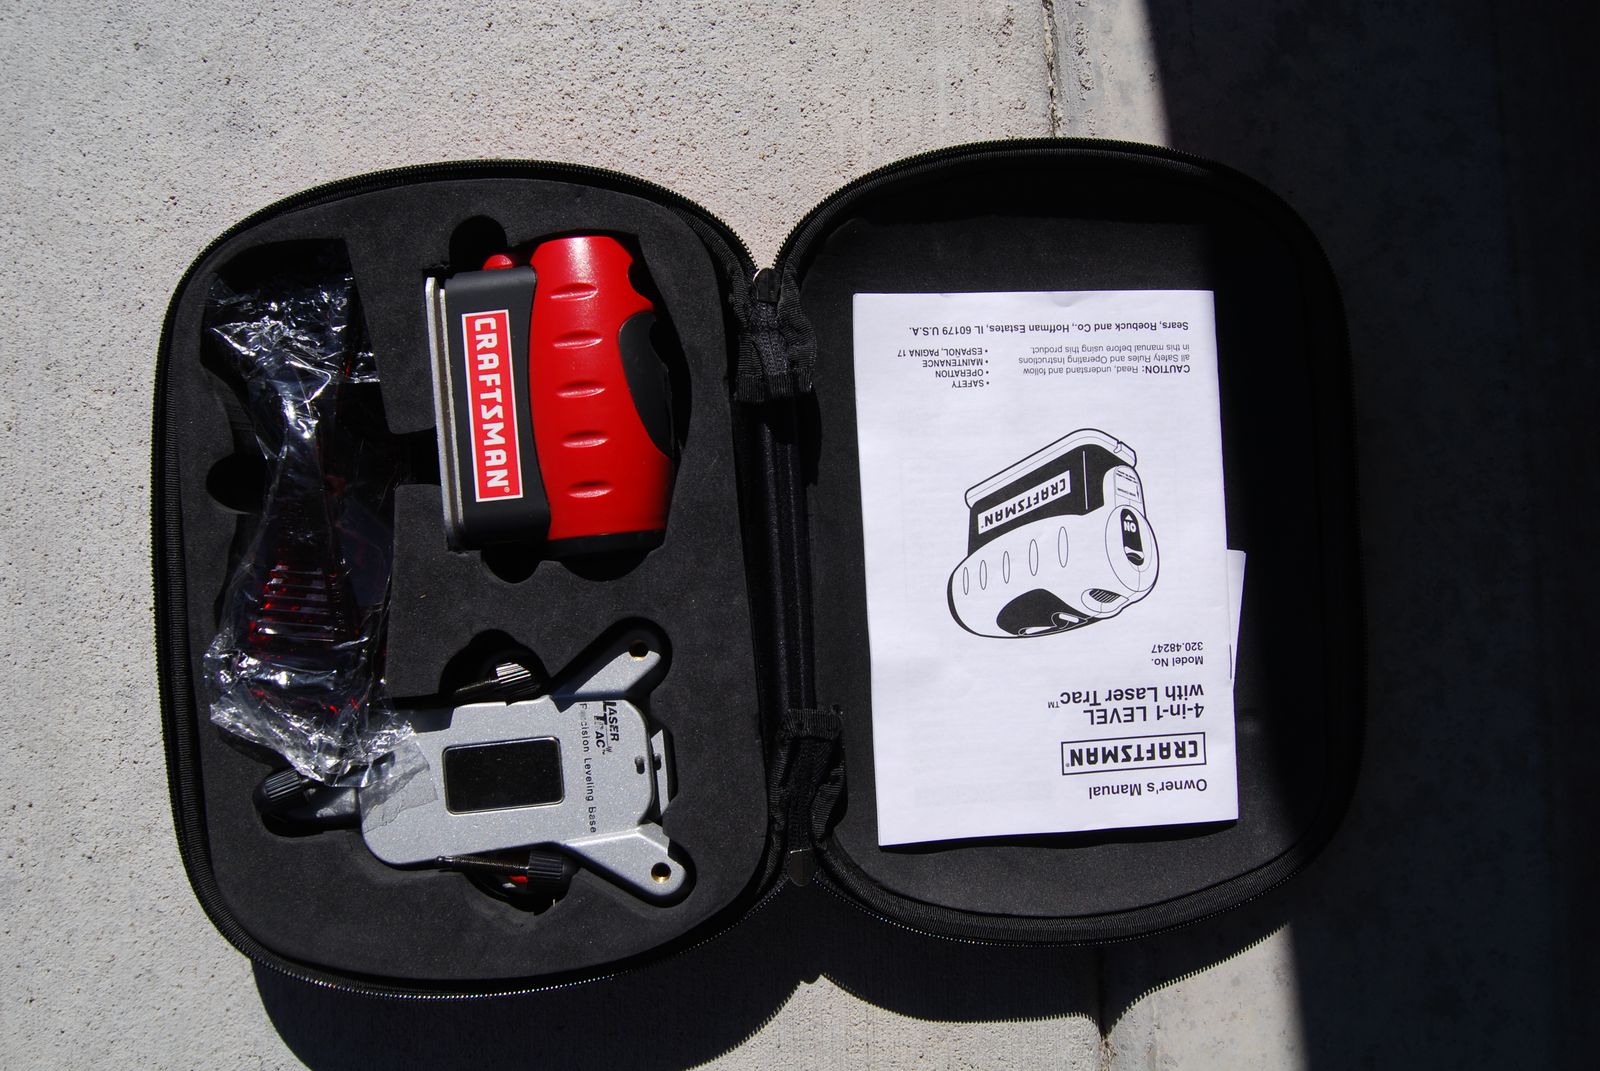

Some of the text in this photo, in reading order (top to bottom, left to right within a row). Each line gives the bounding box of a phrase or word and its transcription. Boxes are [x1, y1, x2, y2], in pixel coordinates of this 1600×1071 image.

[910, 322, 1188, 336] Sears, Roebuck and Co., Hoffman Estates, IL 60179 U.S.A.
[909, 349, 939, 357] PAGINA
[1030, 345, 1062, 354] product.
[1065, 346, 1079, 354] this
[1082, 345, 1103, 353] using
[1106, 345, 1132, 353] before
[1019, 357, 1065, 365] Instructions
[1068, 355, 1107, 364] Operating
[1128, 355, 1151, 363] Rules
[1154, 354, 1178, 362] Safety
[1181, 354, 1190, 362] all
[922, 358, 983, 368] MAINTENANCE
[935, 369, 983, 378] OPERATION
[1048, 367, 1063, 375] and
[1114, 365, 1138, 373] Read,
[1142, 365, 1190, 373] CAUTION:
[952, 380, 984, 388] SAFETY
[1124, 521, 1137, 533] ON
[1152, 642, 1203, 653] 320.48247
[1152, 656, 1203, 667] Model No.
[1105, 687, 1157, 702] Laser
[1165, 684, 1204, 701] with
[1083, 703, 1204, 725] 4-in-1 LEVEL
[603, 701, 619, 741] LASER
[584, 758, 594, 801] Leveling
[1089, 779, 1207, 799] Owner's Manual
